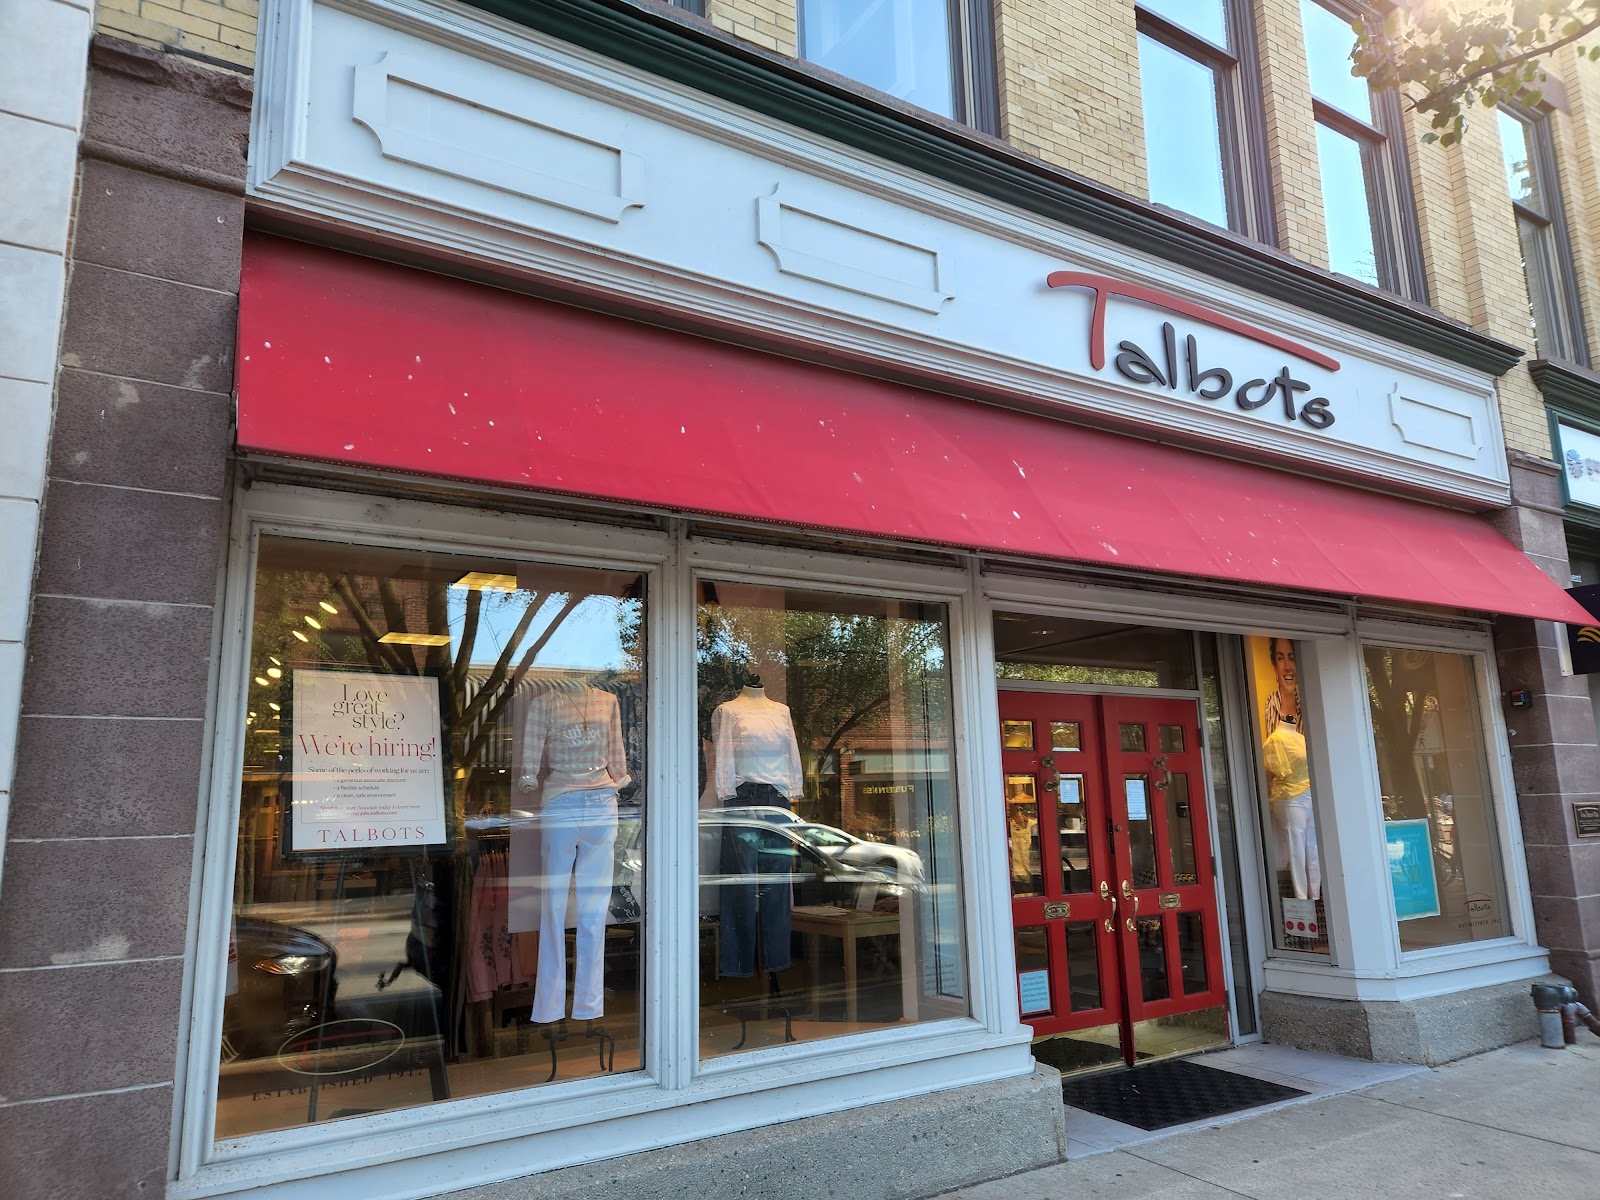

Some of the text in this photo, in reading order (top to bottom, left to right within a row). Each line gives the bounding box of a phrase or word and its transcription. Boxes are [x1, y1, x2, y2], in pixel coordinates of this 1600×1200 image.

[1047, 270, 1341, 430] Talbots
[342, 683, 389, 702] Love
[332, 699, 380, 718] great
[352, 711, 405, 733] style?
[298, 734, 437, 762] We're hiring!
[308, 766, 327, 774] Some
[328, 766, 337, 774] of
[336, 766, 347, 774] the
[347, 767, 366, 775] perks
[374, 767, 400, 775] working
[317, 826, 426, 843] TALBOTS
[252, 1076, 374, 1102] ESTABISHED
